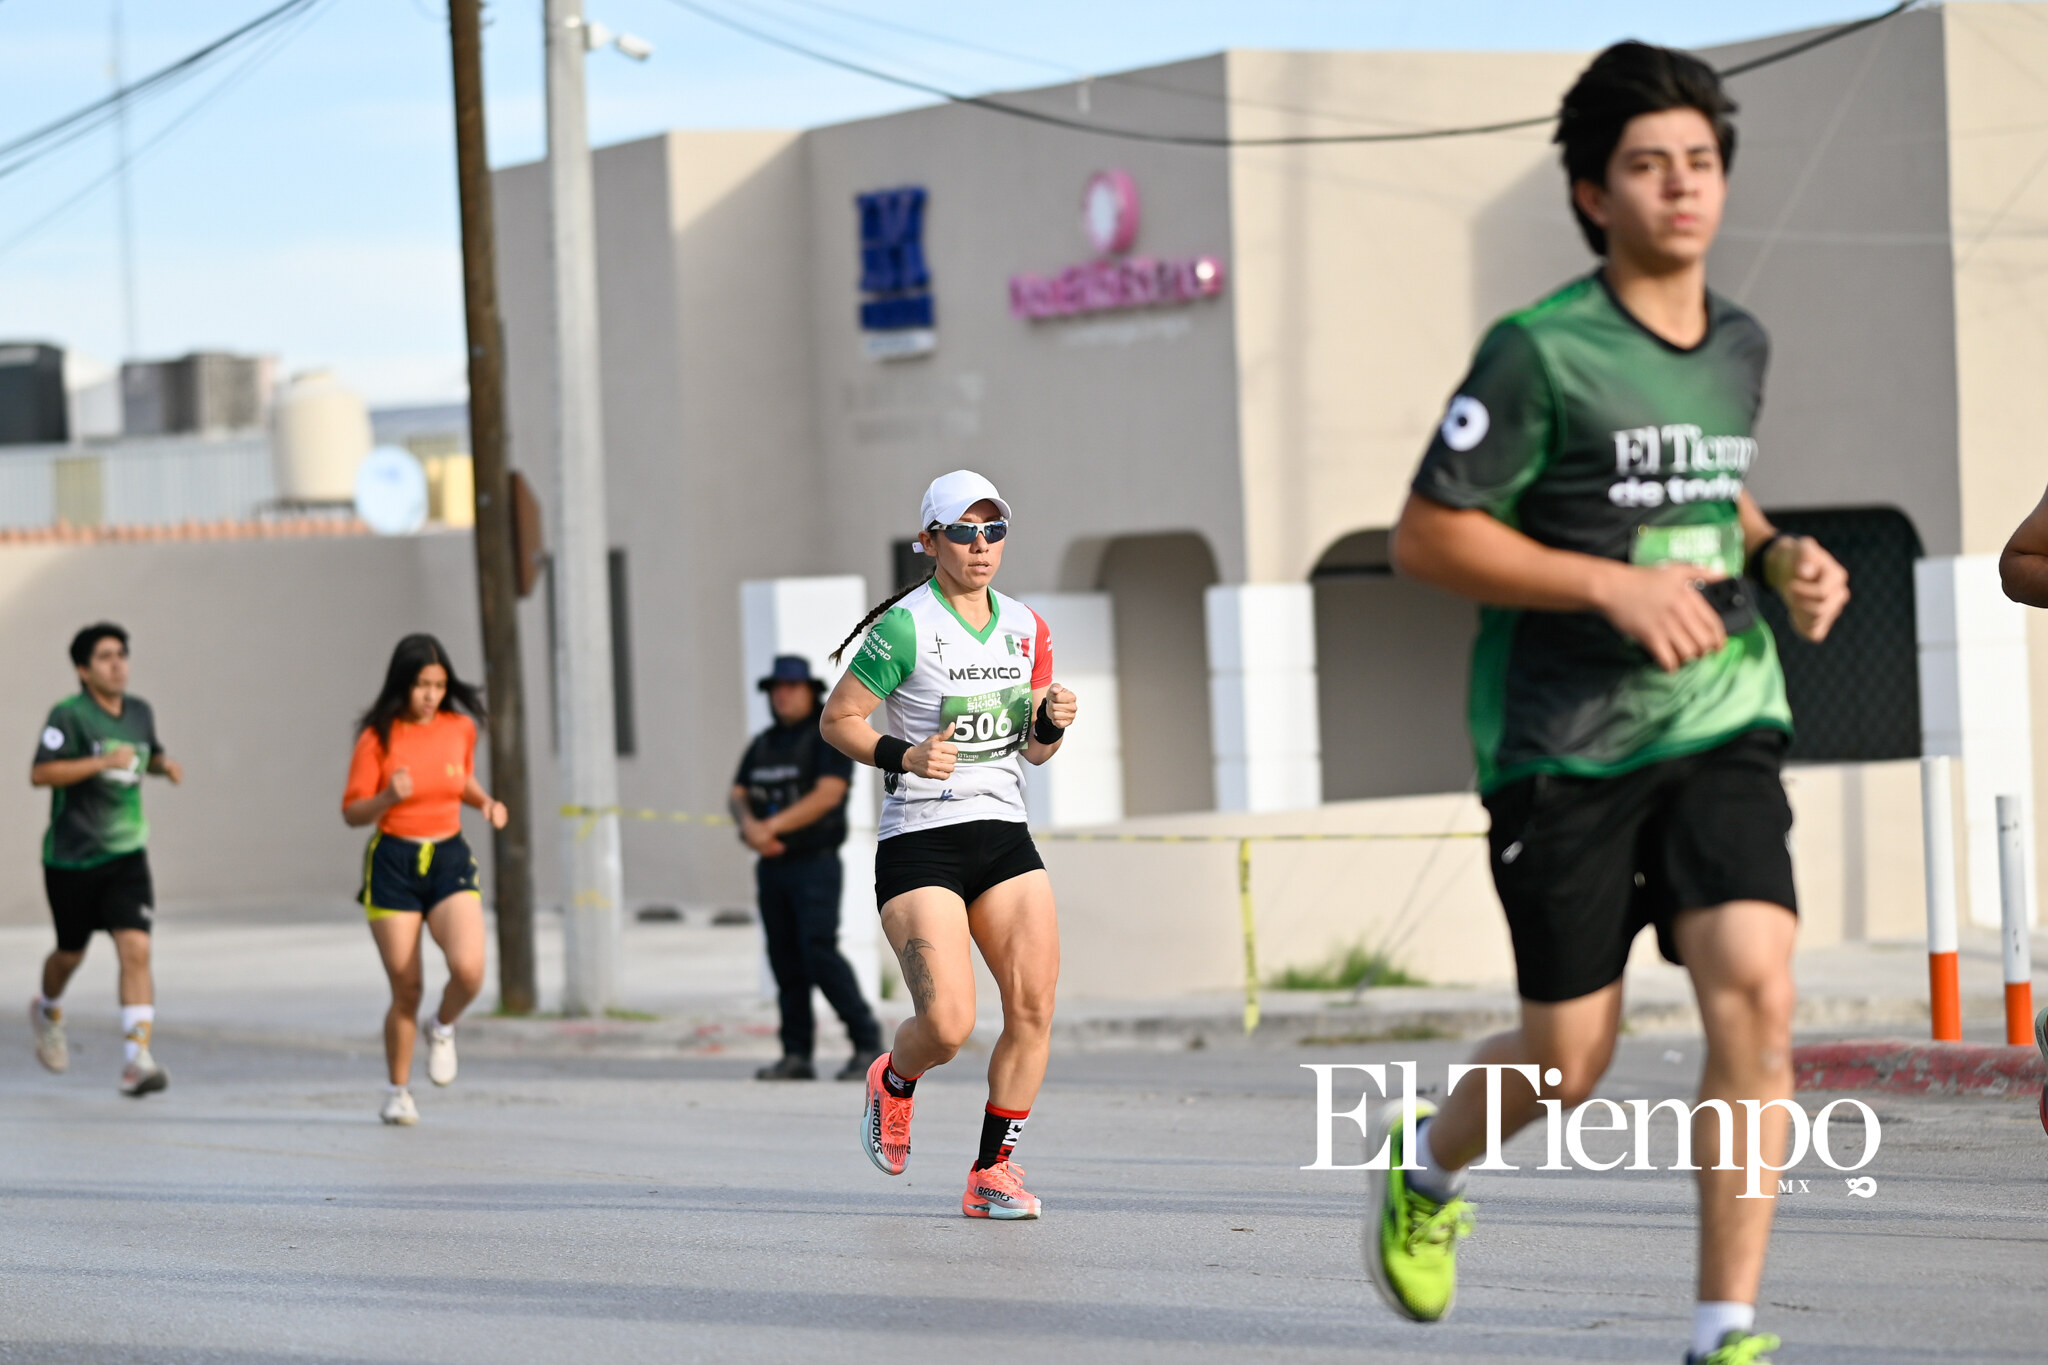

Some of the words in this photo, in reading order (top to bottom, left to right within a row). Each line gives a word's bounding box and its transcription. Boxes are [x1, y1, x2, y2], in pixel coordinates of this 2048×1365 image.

[1612, 425, 1660, 475] El
[878, 638, 893, 651] KM
[949, 664, 1021, 681] MÉXICO
[967, 692, 1001, 703] CARRERA
[953, 709, 1013, 742] 506
[1020, 697, 1031, 742] MEDALLA
[872, 1099, 883, 1155] BROOKS
[977, 1186, 1014, 1202] BROOKS
